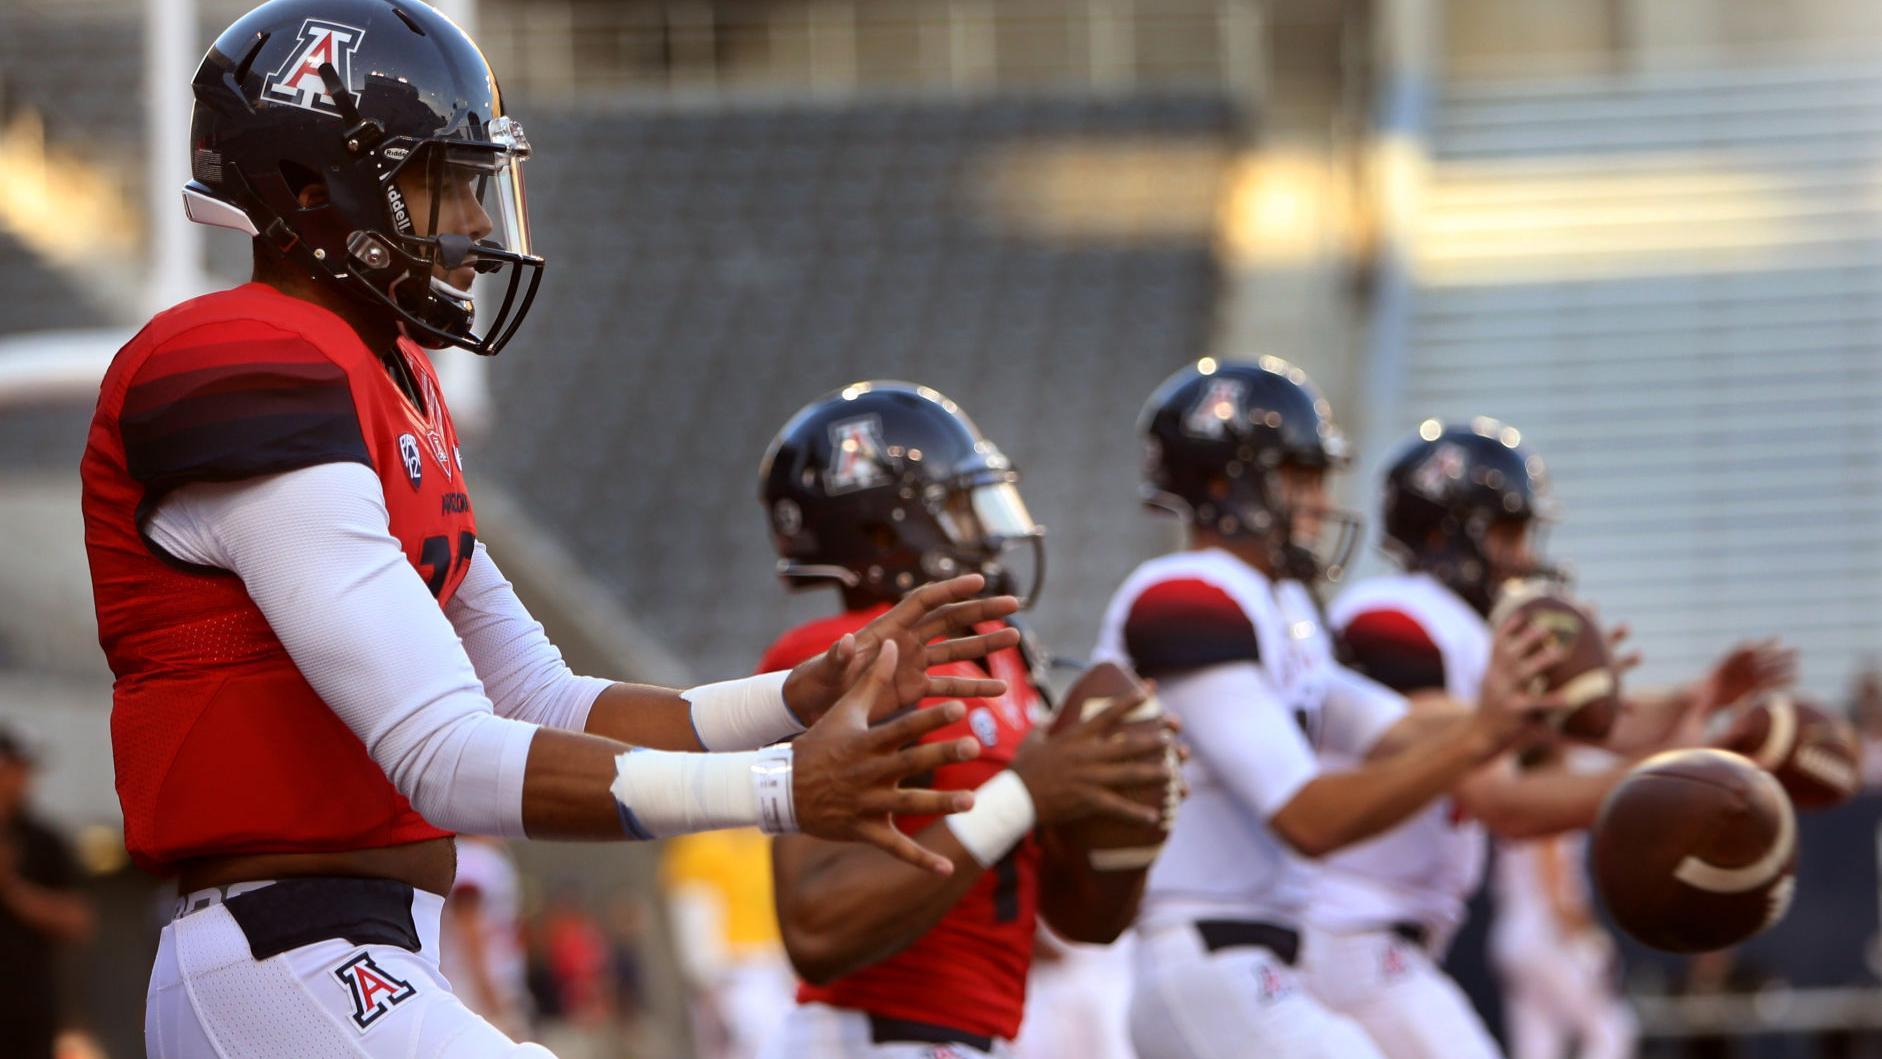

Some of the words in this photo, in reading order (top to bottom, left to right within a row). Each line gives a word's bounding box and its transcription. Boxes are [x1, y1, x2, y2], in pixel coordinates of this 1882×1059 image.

[261, 18, 365, 119] A
[408, 456, 421, 479] 12
[822, 412, 896, 497] A
[334, 951, 417, 1029] A
